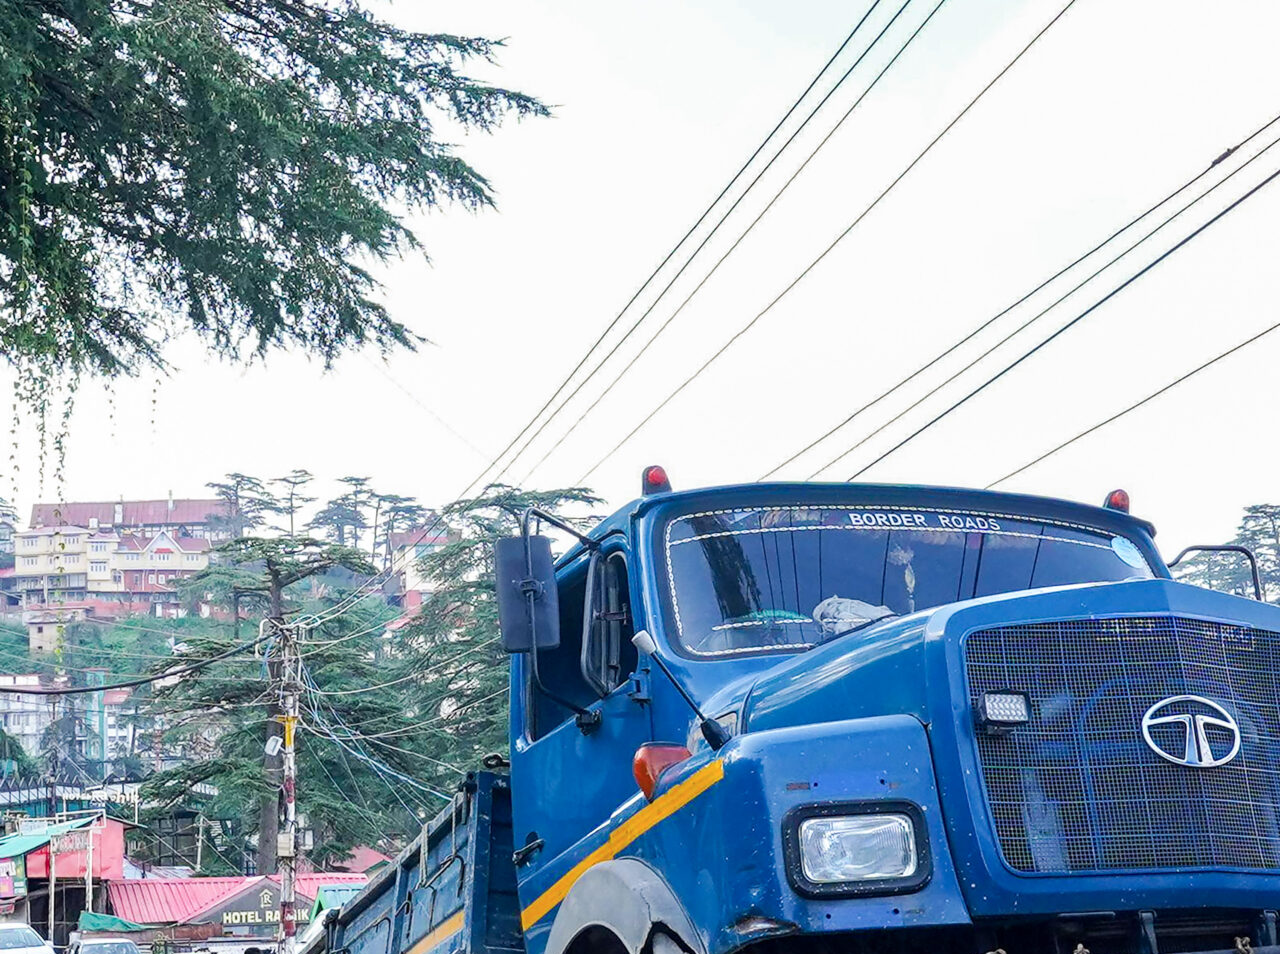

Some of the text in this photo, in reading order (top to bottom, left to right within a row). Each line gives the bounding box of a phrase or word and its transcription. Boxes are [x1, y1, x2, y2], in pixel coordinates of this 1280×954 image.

[849, 512, 1001, 531] BORDER ROADS
[223, 907, 310, 925] HOTEL RAIK
